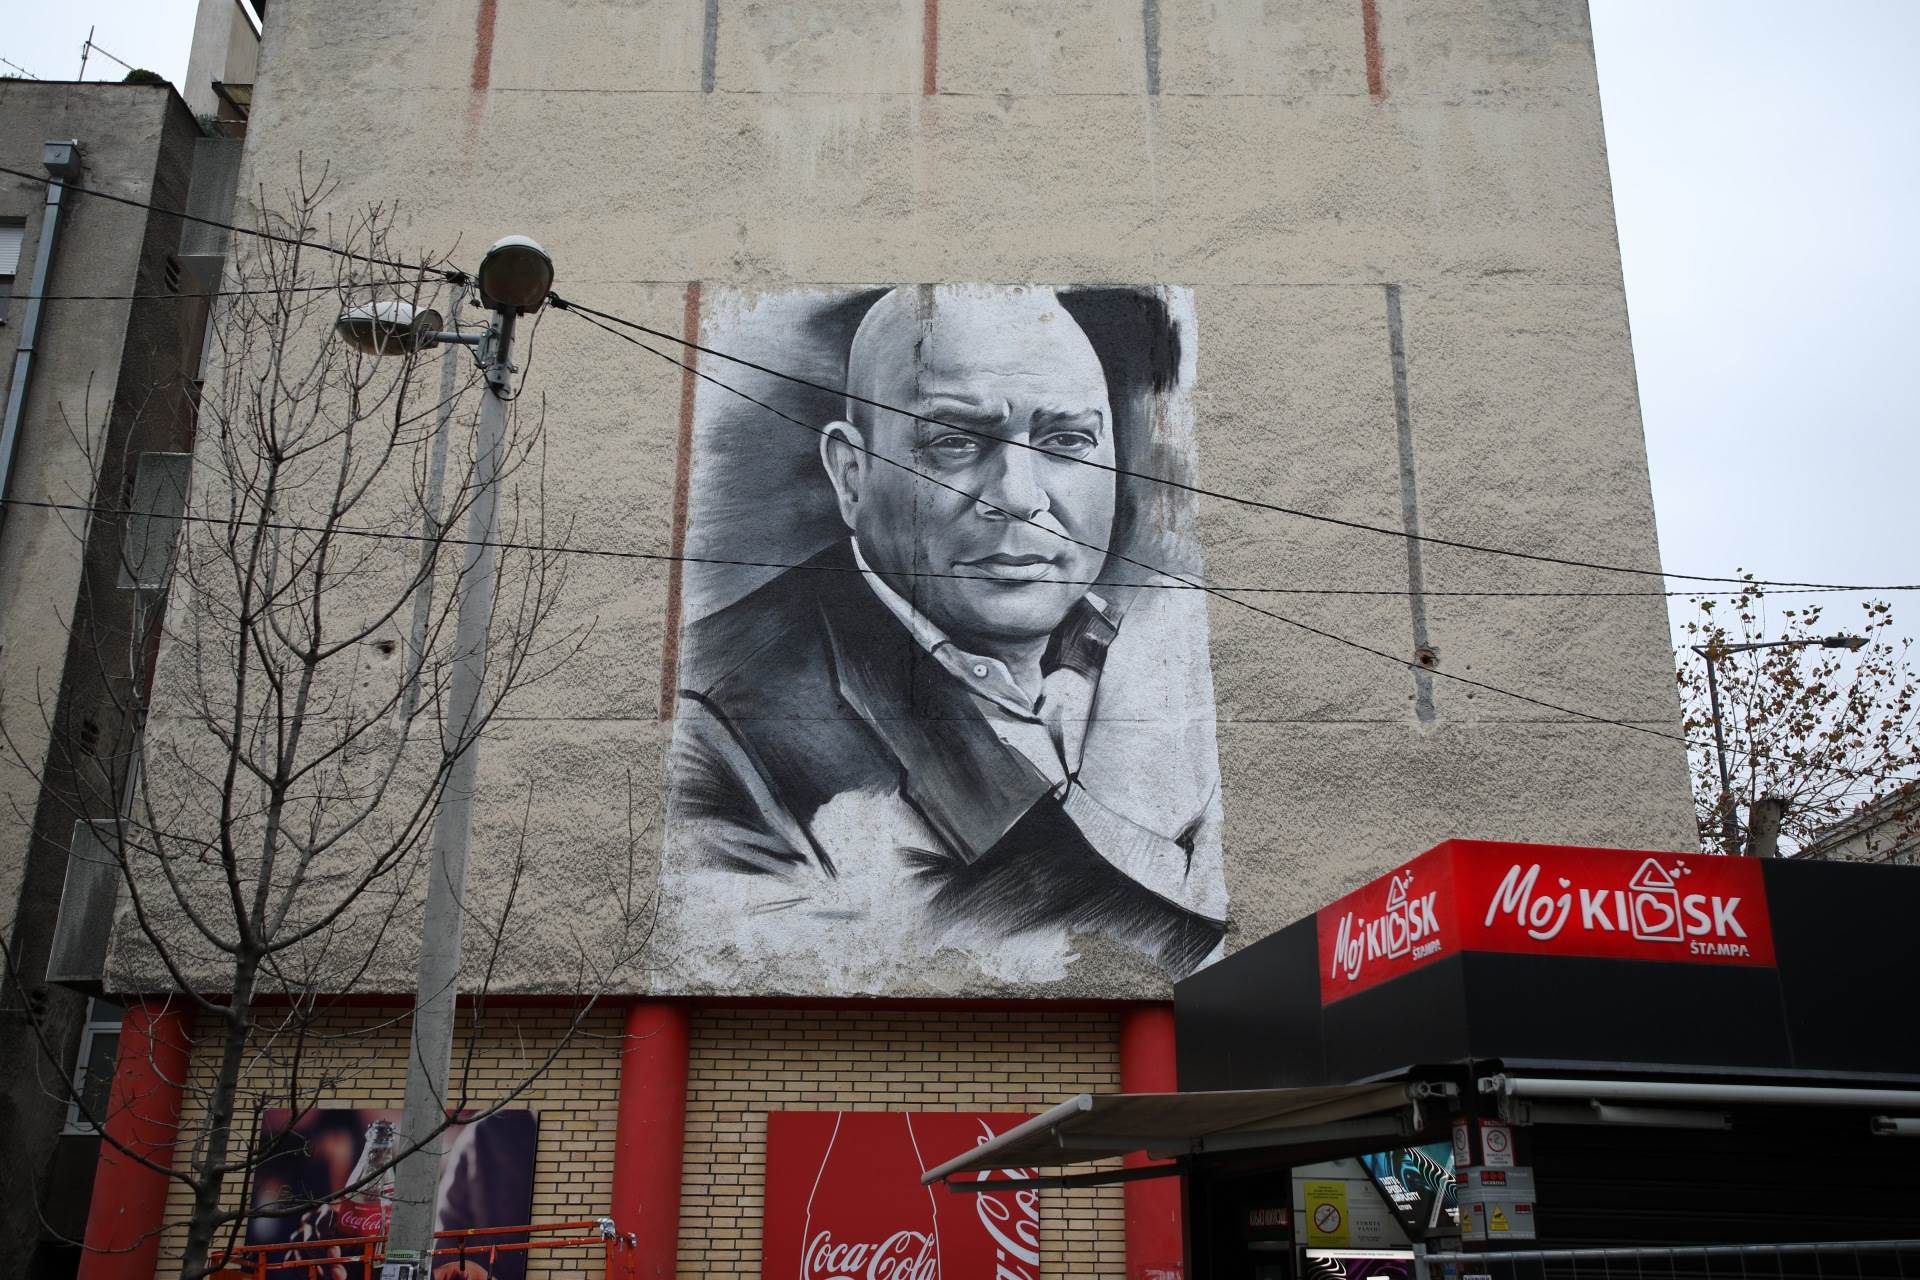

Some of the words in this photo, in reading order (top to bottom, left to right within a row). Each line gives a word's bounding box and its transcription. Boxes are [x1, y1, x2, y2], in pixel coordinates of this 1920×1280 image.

[1484, 863, 1572, 940] Moj
[1331, 911, 1365, 981] Moj
[1690, 939, 1750, 957] ŠTAMPA
